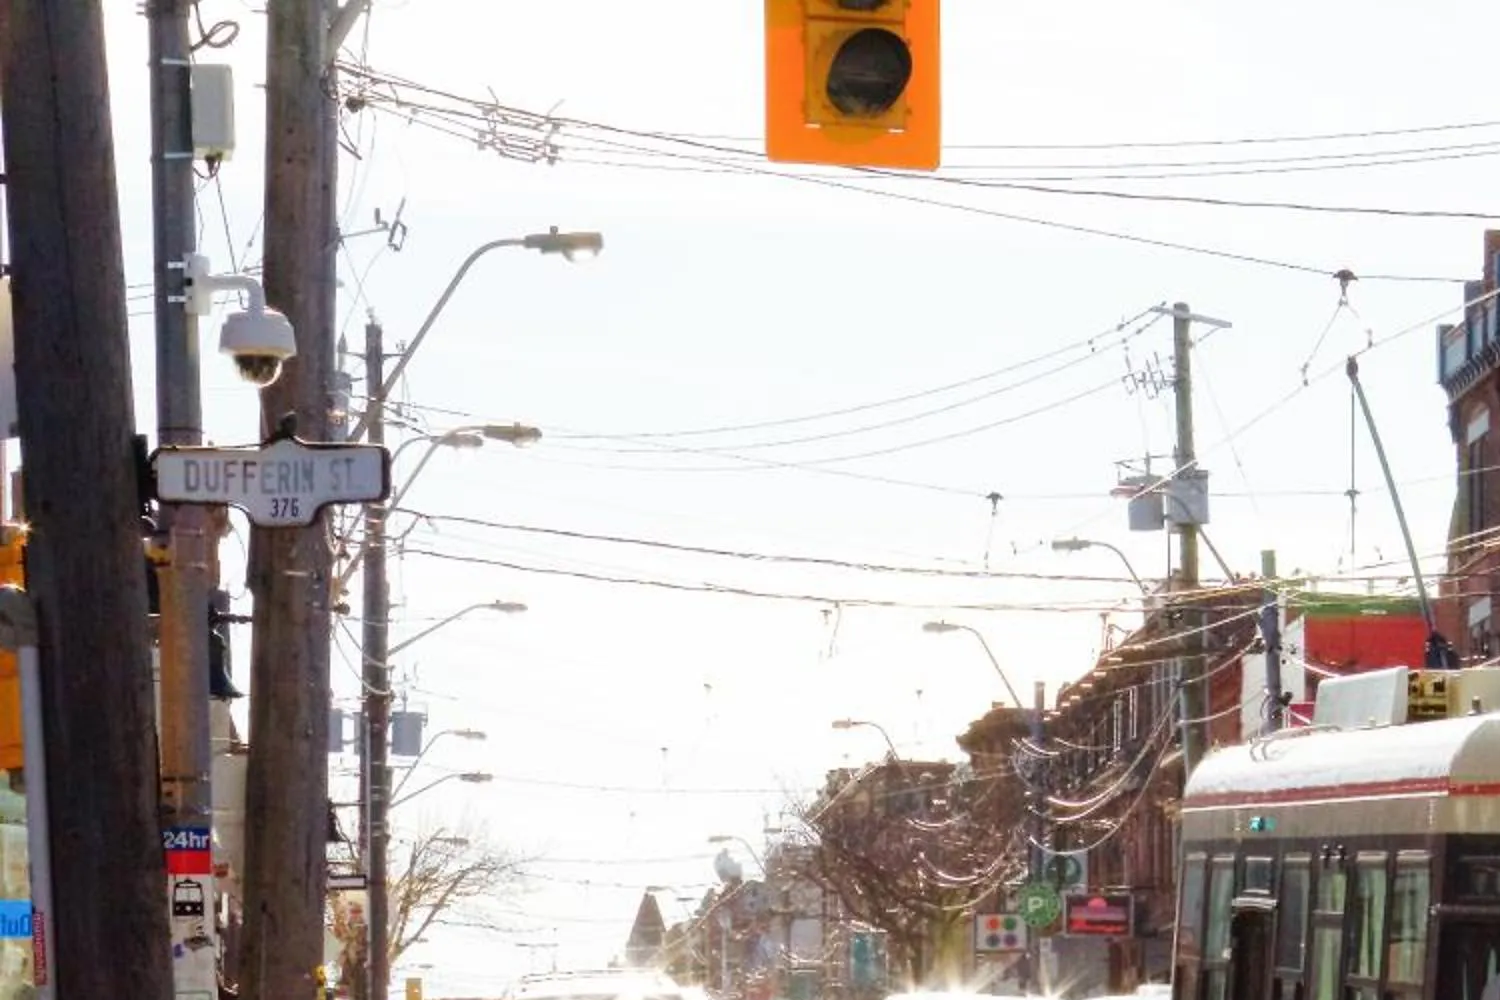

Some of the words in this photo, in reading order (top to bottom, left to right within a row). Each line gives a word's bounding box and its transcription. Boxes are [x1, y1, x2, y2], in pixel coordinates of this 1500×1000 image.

[184, 459, 313, 494] DUFFERIN
[271, 500, 299, 517] 376
[163, 831, 210, 849] 24hr
[1028, 897, 1043, 912] P
